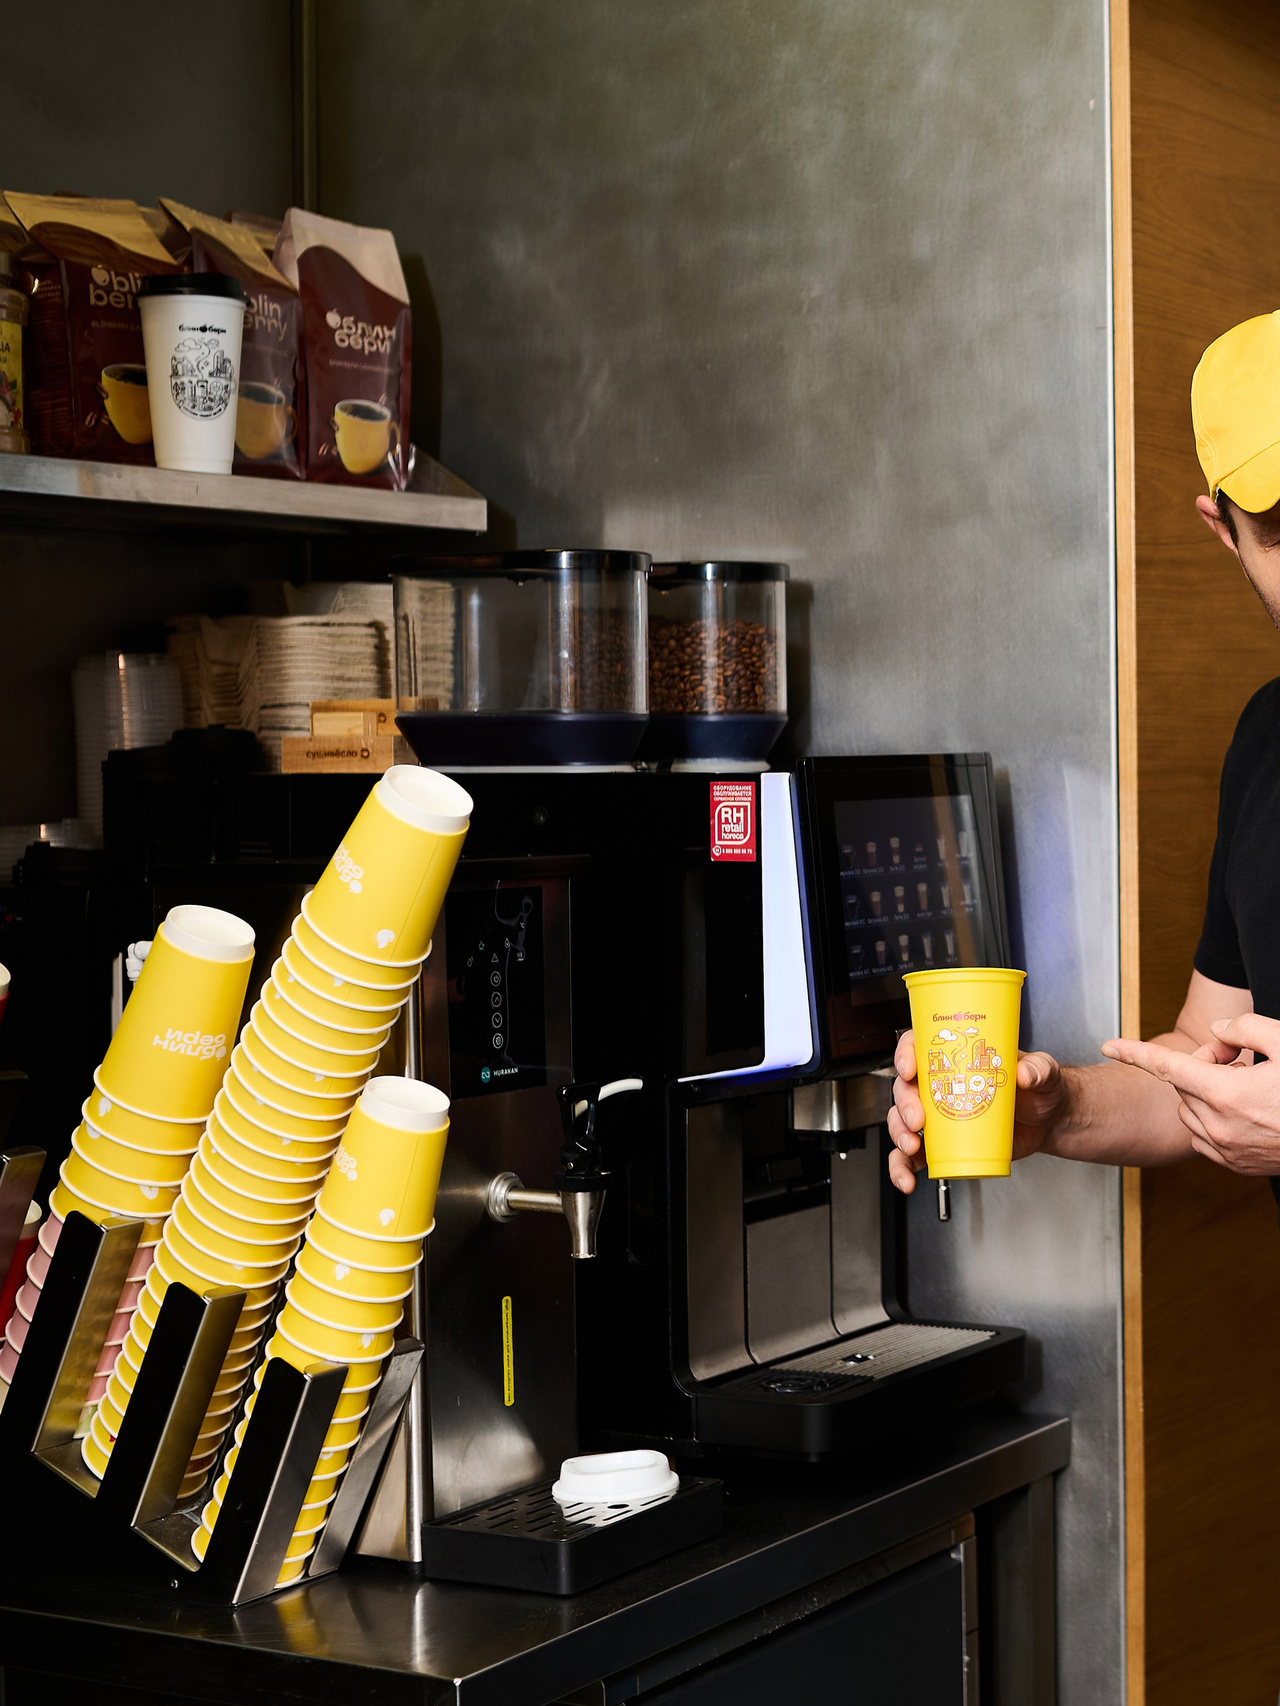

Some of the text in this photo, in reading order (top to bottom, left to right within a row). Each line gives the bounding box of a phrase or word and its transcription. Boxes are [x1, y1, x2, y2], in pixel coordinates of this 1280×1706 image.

[110, 270, 141, 293] bli
[89, 283, 134, 309] ber
[243, 313, 288, 341] erry
[342, 315, 396, 341] блин
[334, 329, 391, 356] бери
[721, 807, 744, 823] RH
[721, 822, 744, 833] retail
[932, 1011, 987, 1022] блин бери
[151, 1034, 216, 1061] блин
[165, 1027, 226, 1049] бери
[493, 1067, 519, 1077] HURAKAN
